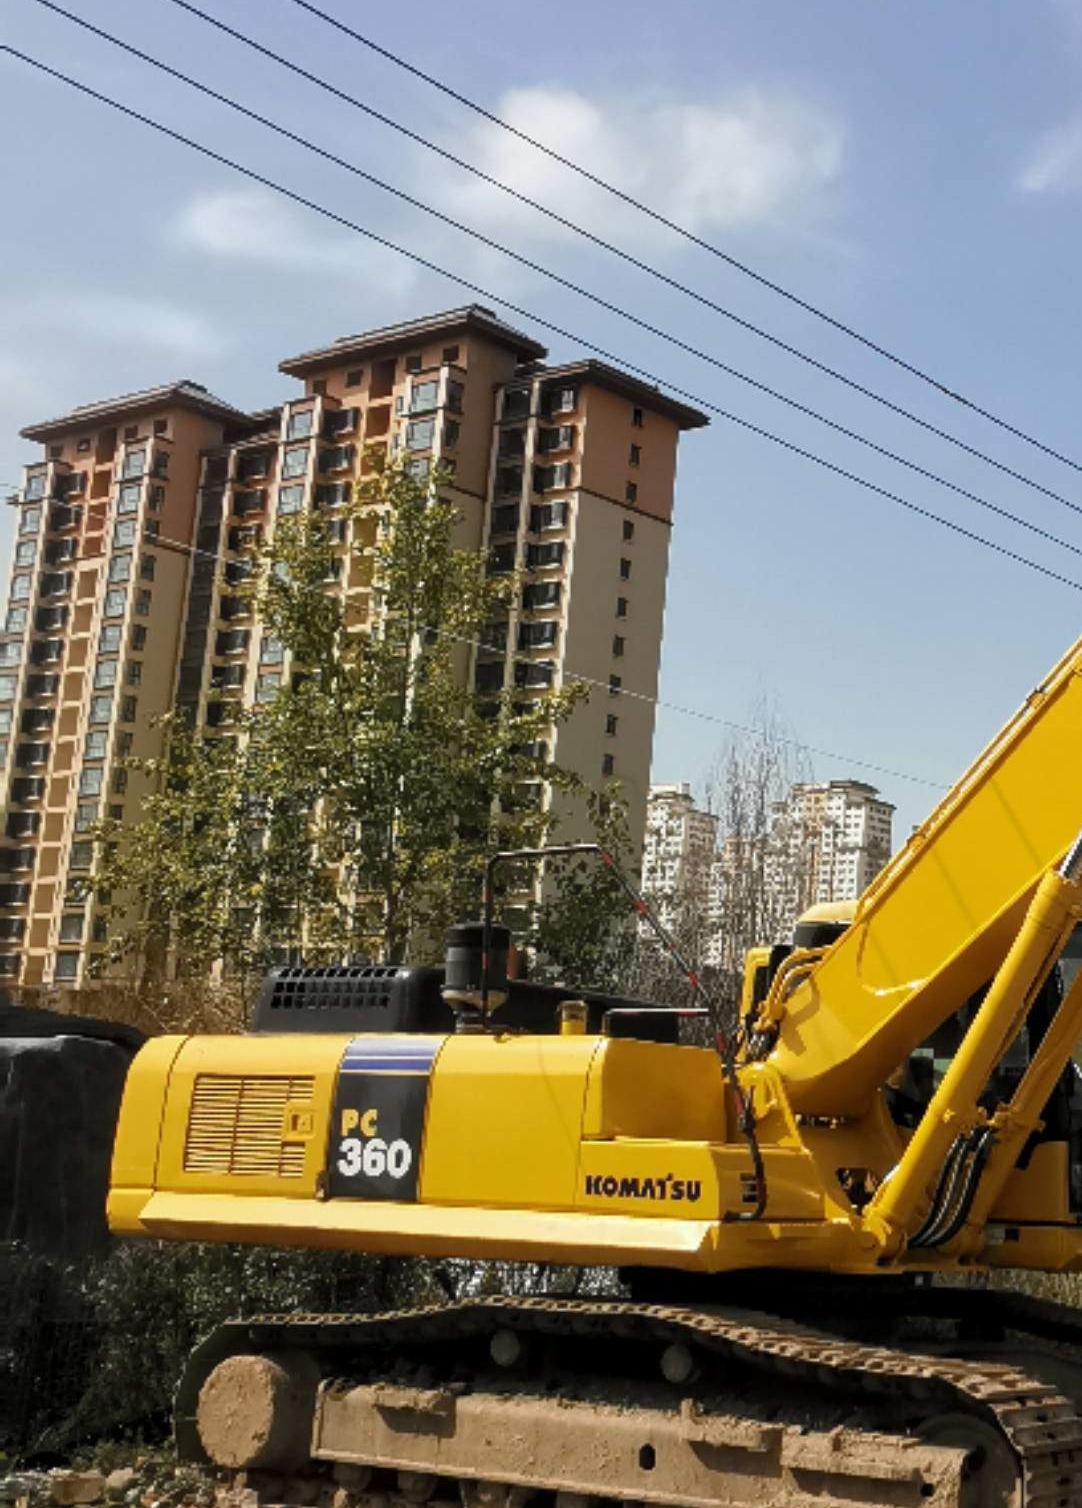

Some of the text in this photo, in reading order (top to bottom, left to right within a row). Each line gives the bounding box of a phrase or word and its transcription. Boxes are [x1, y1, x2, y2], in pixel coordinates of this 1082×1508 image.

[341, 1108, 378, 1137] PC
[336, 1137, 412, 1179] 360
[585, 1173, 701, 1202] KOMATSU
